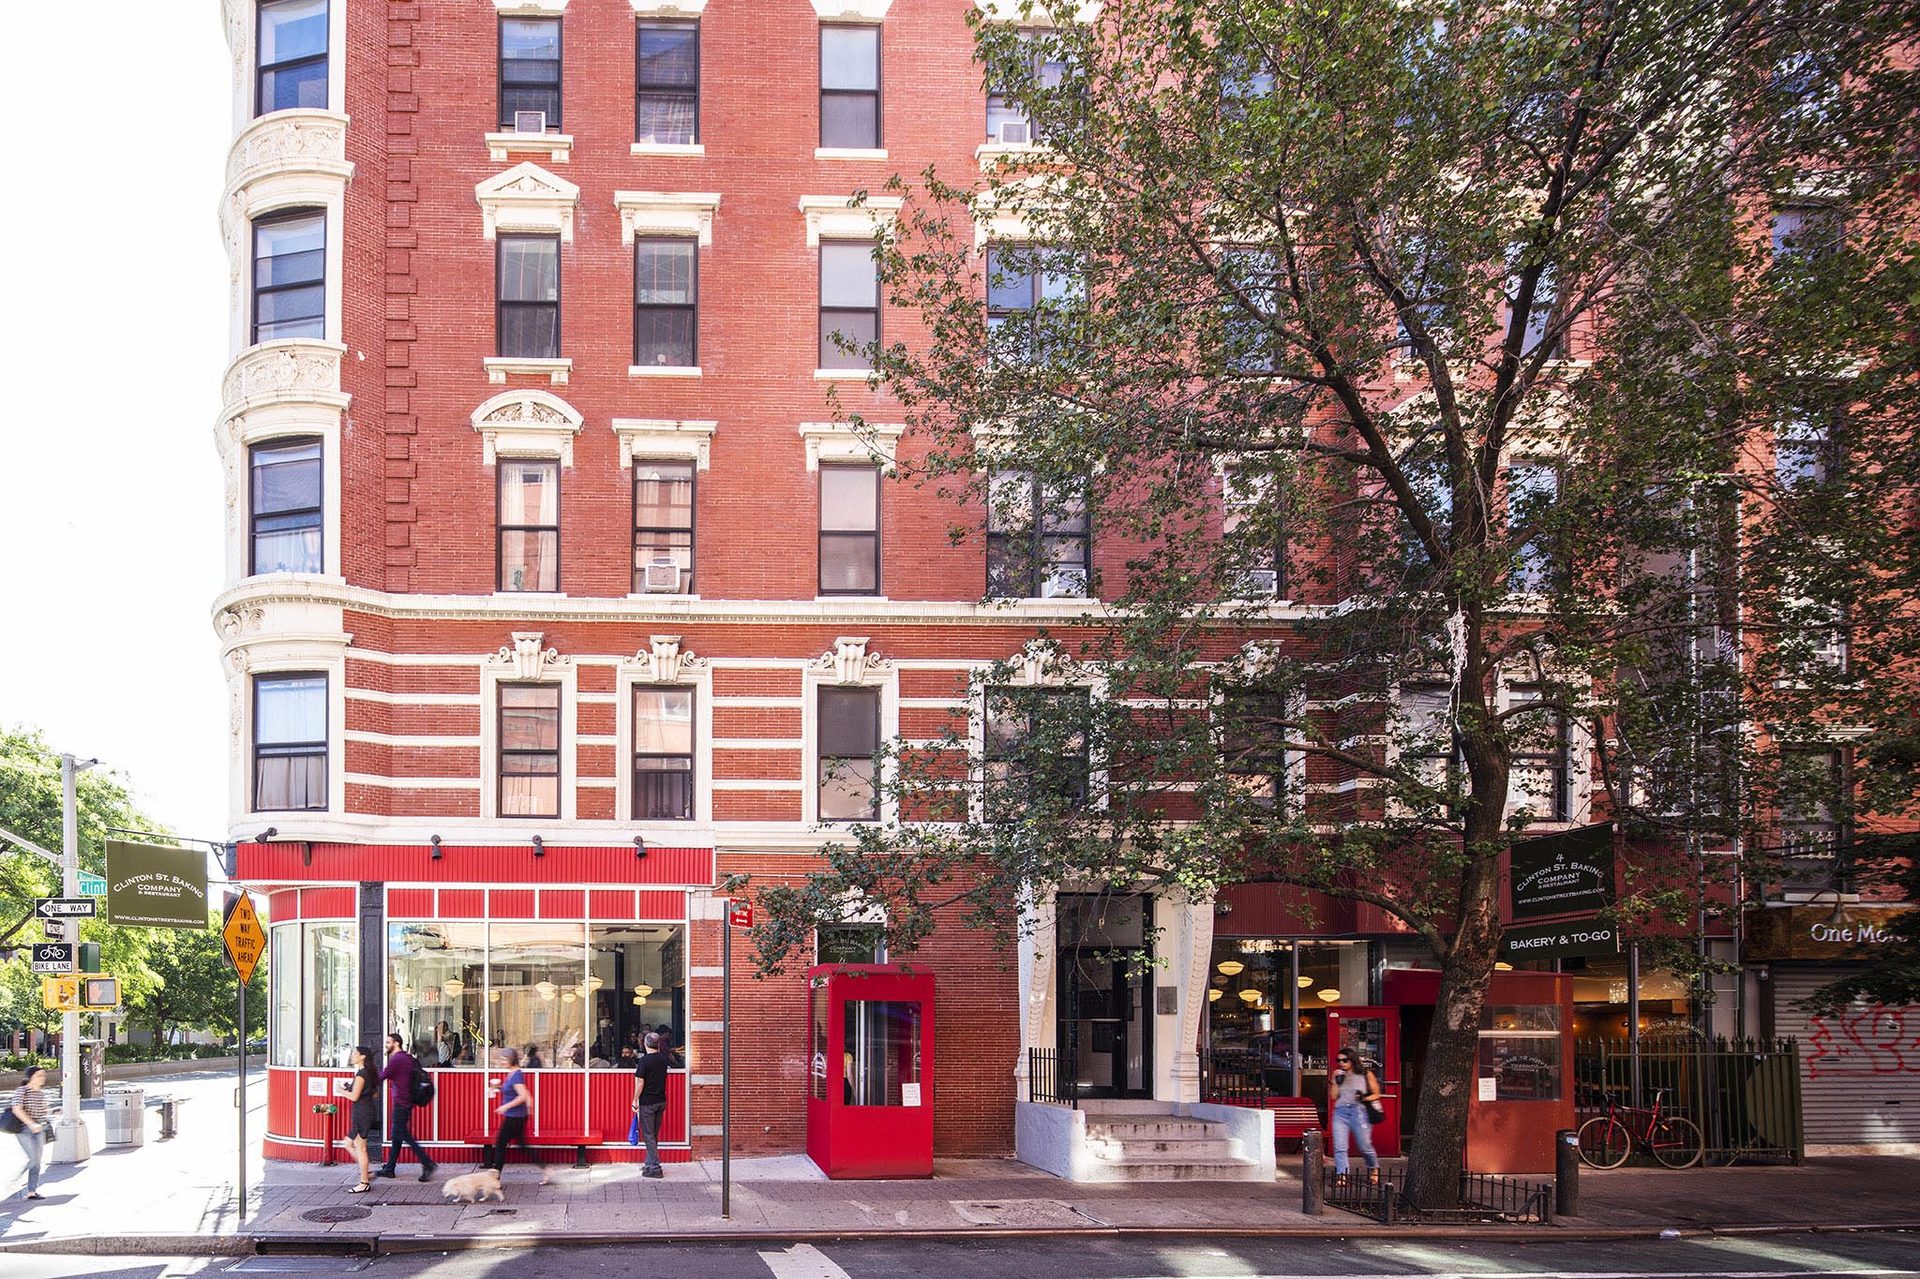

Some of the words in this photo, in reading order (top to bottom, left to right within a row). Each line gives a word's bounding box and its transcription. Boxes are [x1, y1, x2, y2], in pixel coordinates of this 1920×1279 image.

[1516, 866, 1552, 892] CLINTON
[1553, 863, 1568, 872] ST.
[1570, 862, 1605, 878] BAKING
[1537, 871, 1581, 885] COMPANY
[1542, 878, 1580, 888] RESTAURANT
[80, 882, 108, 894] Clint
[113, 874, 153, 893] CLINTON
[155, 872, 170, 882] ST.
[172, 875, 205, 899] BAKING
[137, 883, 182, 893] COMPANY
[1518, 887, 1605, 905] WWW.CLINTONSTREETBAKING.COM
[44, 904, 62, 913] ONE
[70, 904, 88, 913] WAY
[240, 907, 251, 921] TWO
[49, 924, 61, 933] ONE
[240, 923, 251, 934] WAY
[1811, 923, 1853, 942] One
[1856, 924, 1909, 943] Mo
[235, 936, 256, 950] TRAFFIC
[1510, 936, 1556, 950] BAKERY
[1559, 935, 1569, 945] &
[1571, 930, 1611, 943] TO-GO
[237, 951, 254, 964] AHEAD
[34, 961, 50, 971] BIKE
[52, 961, 71, 971] LANE
